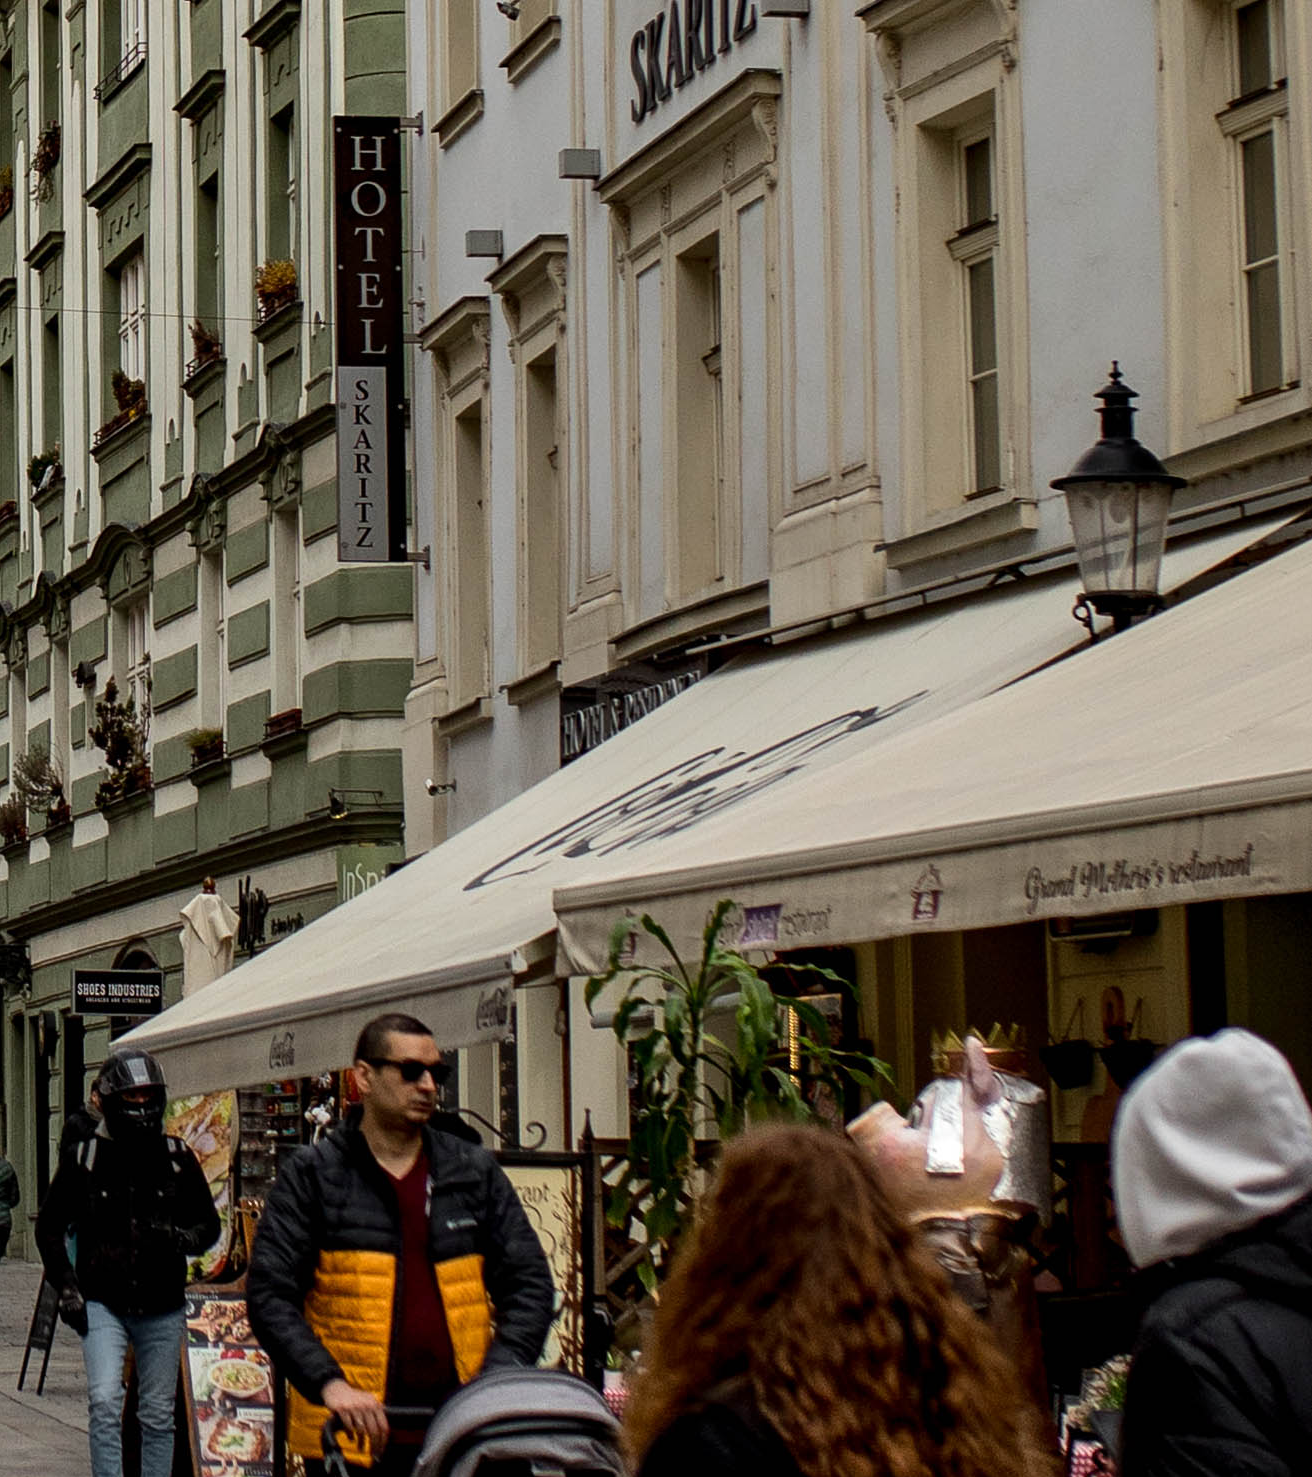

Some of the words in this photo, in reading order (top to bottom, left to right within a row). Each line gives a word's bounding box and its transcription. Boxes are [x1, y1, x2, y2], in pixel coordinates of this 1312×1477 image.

[350, 135, 387, 356] HOTEL
[353, 379, 374, 549] SKARITZ
[77, 982, 106, 996] SHOES
[108, 983, 160, 997] INDUSTRIES
